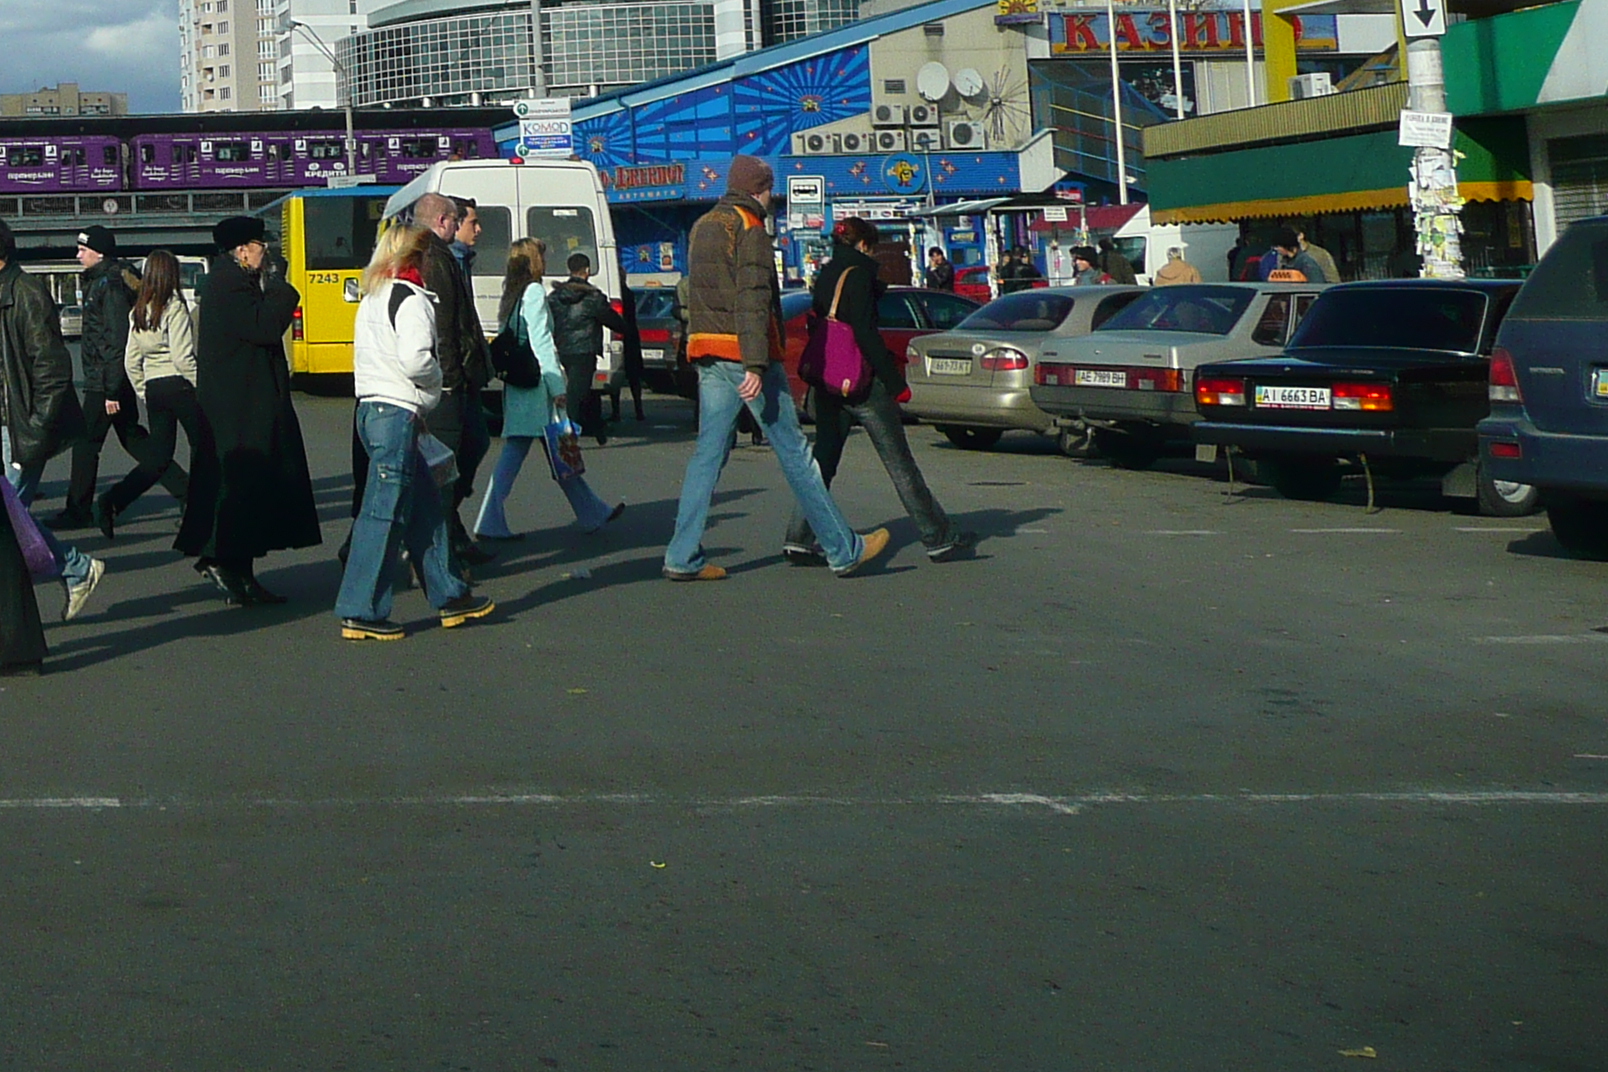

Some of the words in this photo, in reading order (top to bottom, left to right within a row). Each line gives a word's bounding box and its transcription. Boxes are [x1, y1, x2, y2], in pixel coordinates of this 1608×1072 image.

[1062, 11, 1303, 50] КАЗИН
[523, 122, 569, 135] KOMOD
[308, 273, 339, 284] 7243
[1263, 388, 1276, 402] AI
[1281, 388, 1306, 402] 6663
[1309, 389, 1326, 403] BA
